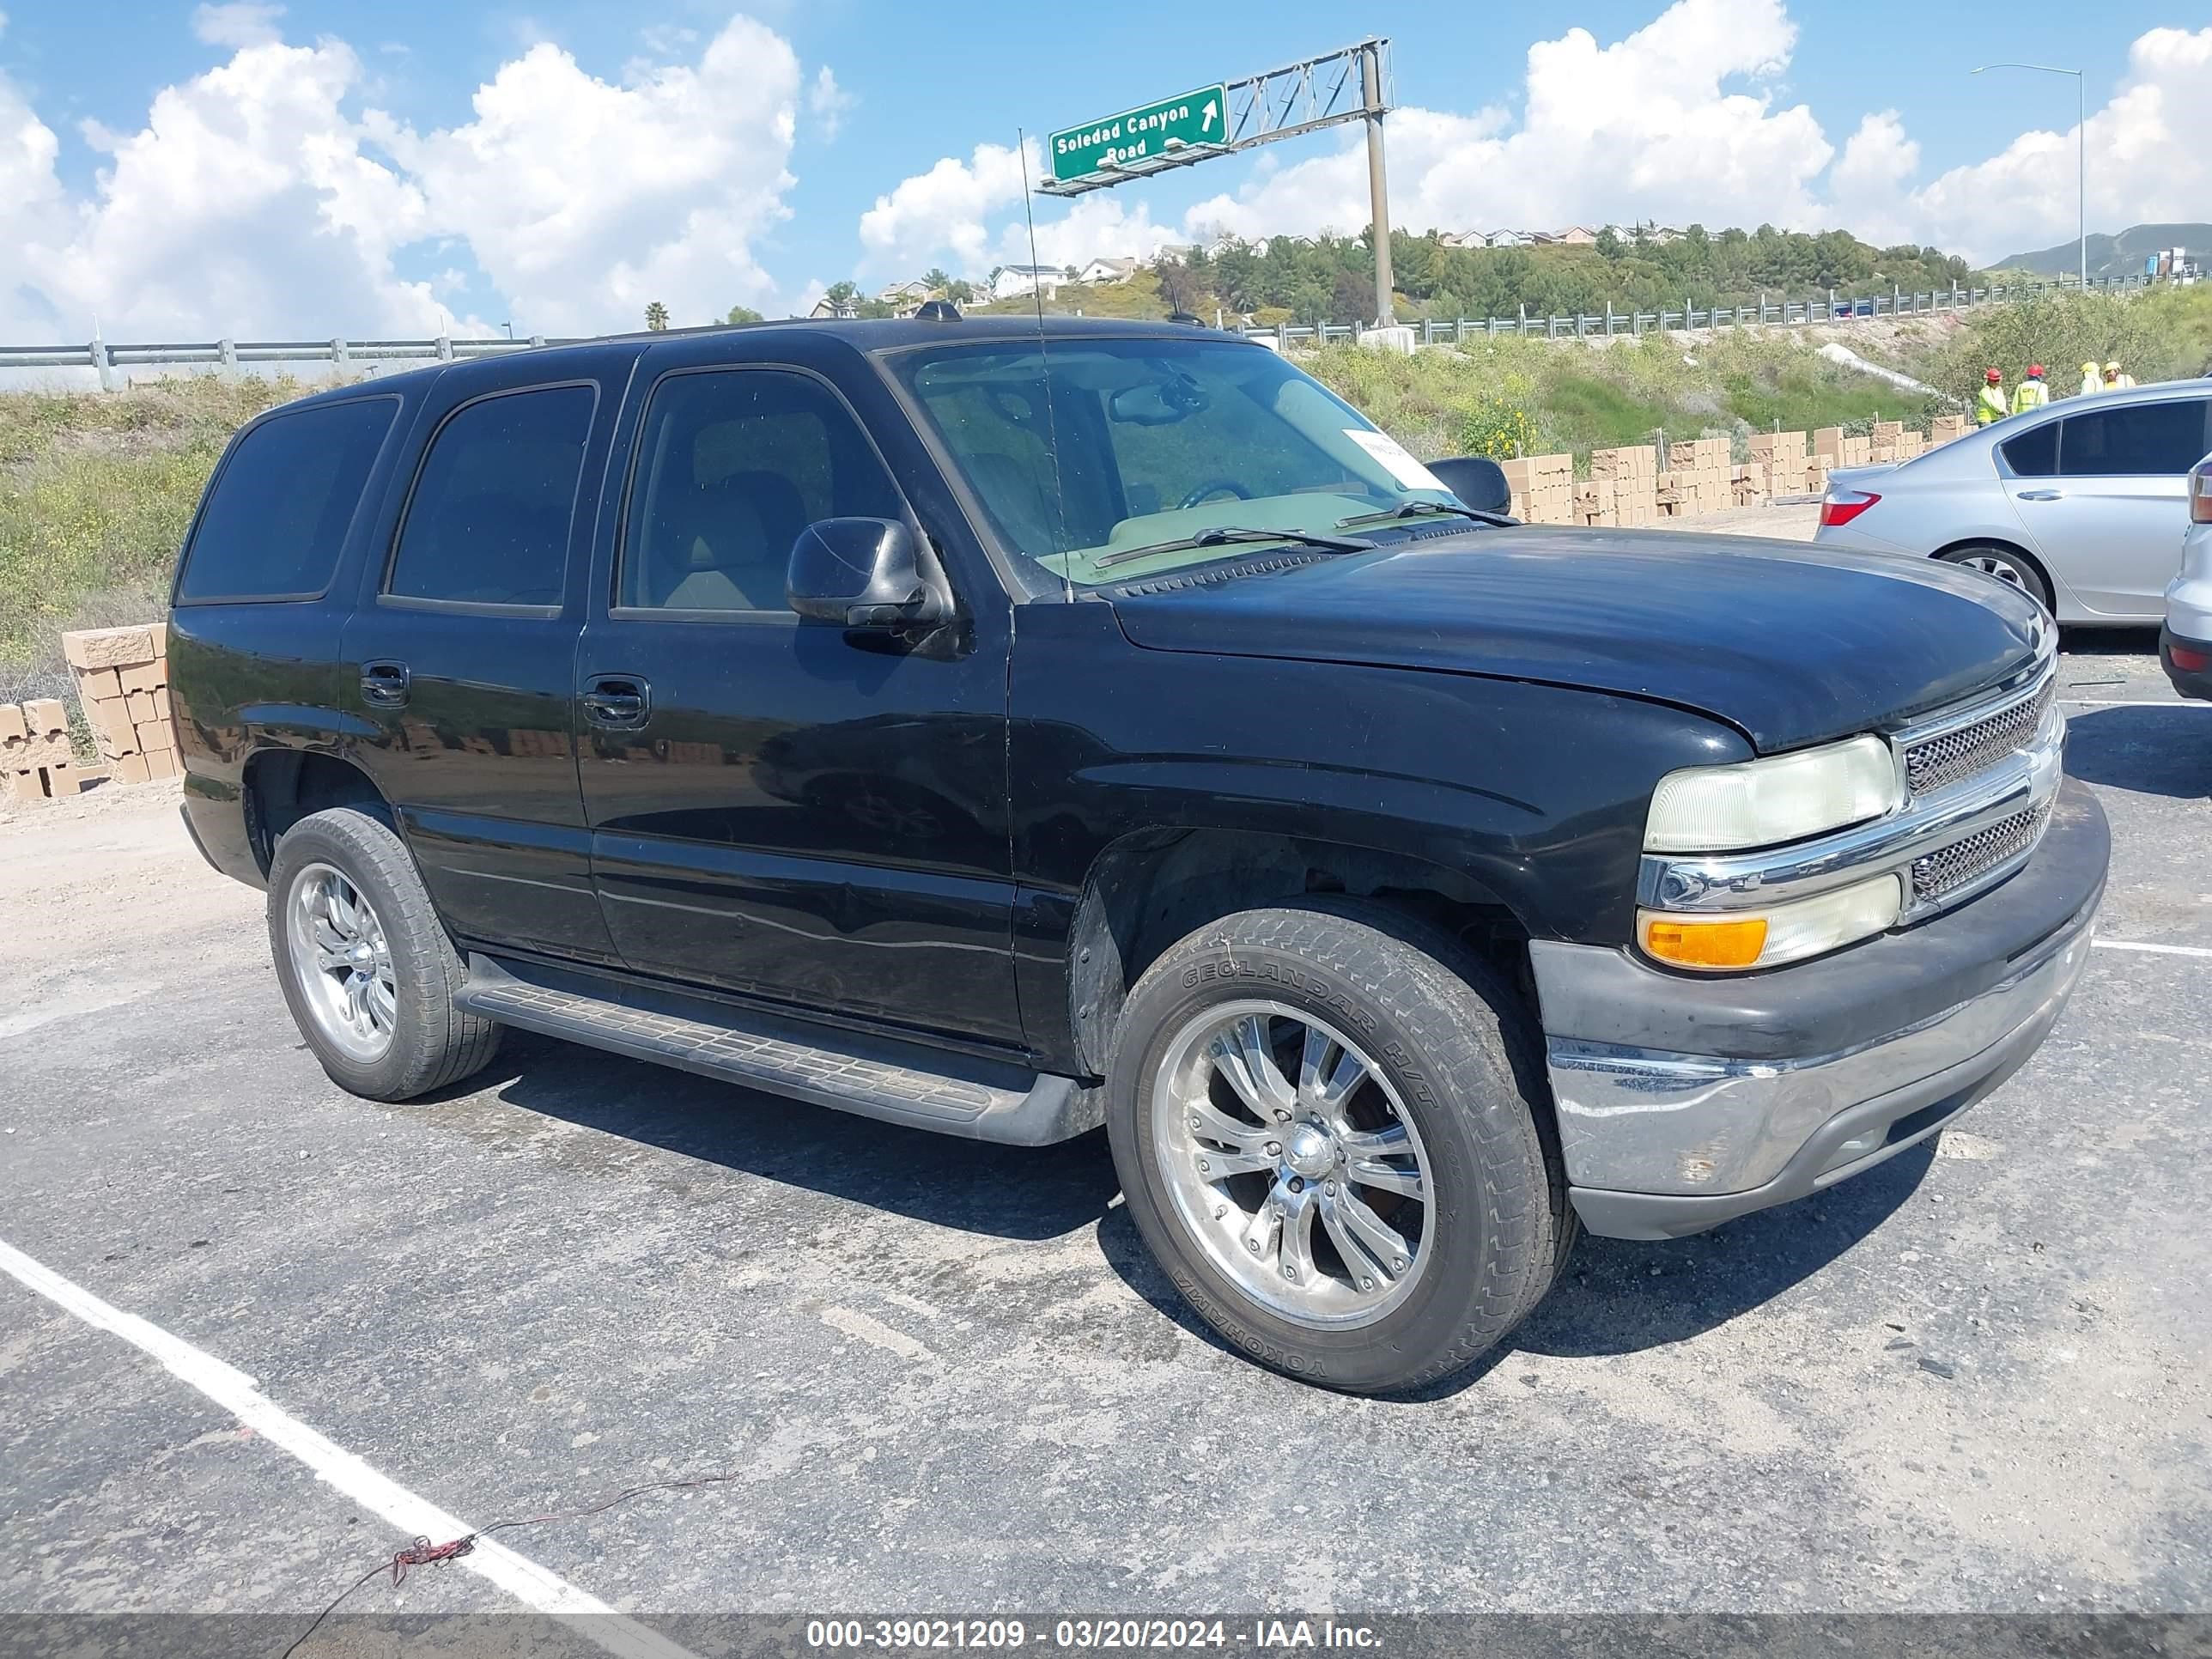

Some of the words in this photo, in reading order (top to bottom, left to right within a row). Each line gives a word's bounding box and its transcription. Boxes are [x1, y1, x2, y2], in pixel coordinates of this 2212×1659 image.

[1057, 123, 1121, 155] Soledad
[1127, 105, 1189, 132] Canyon
[1106, 138, 1146, 161] Road
[1182, 959, 1377, 1035] GEOLANDAR
[1384, 1042, 1439, 1109] H/T
[1171, 1269, 1329, 1378] YOKOHAMA
